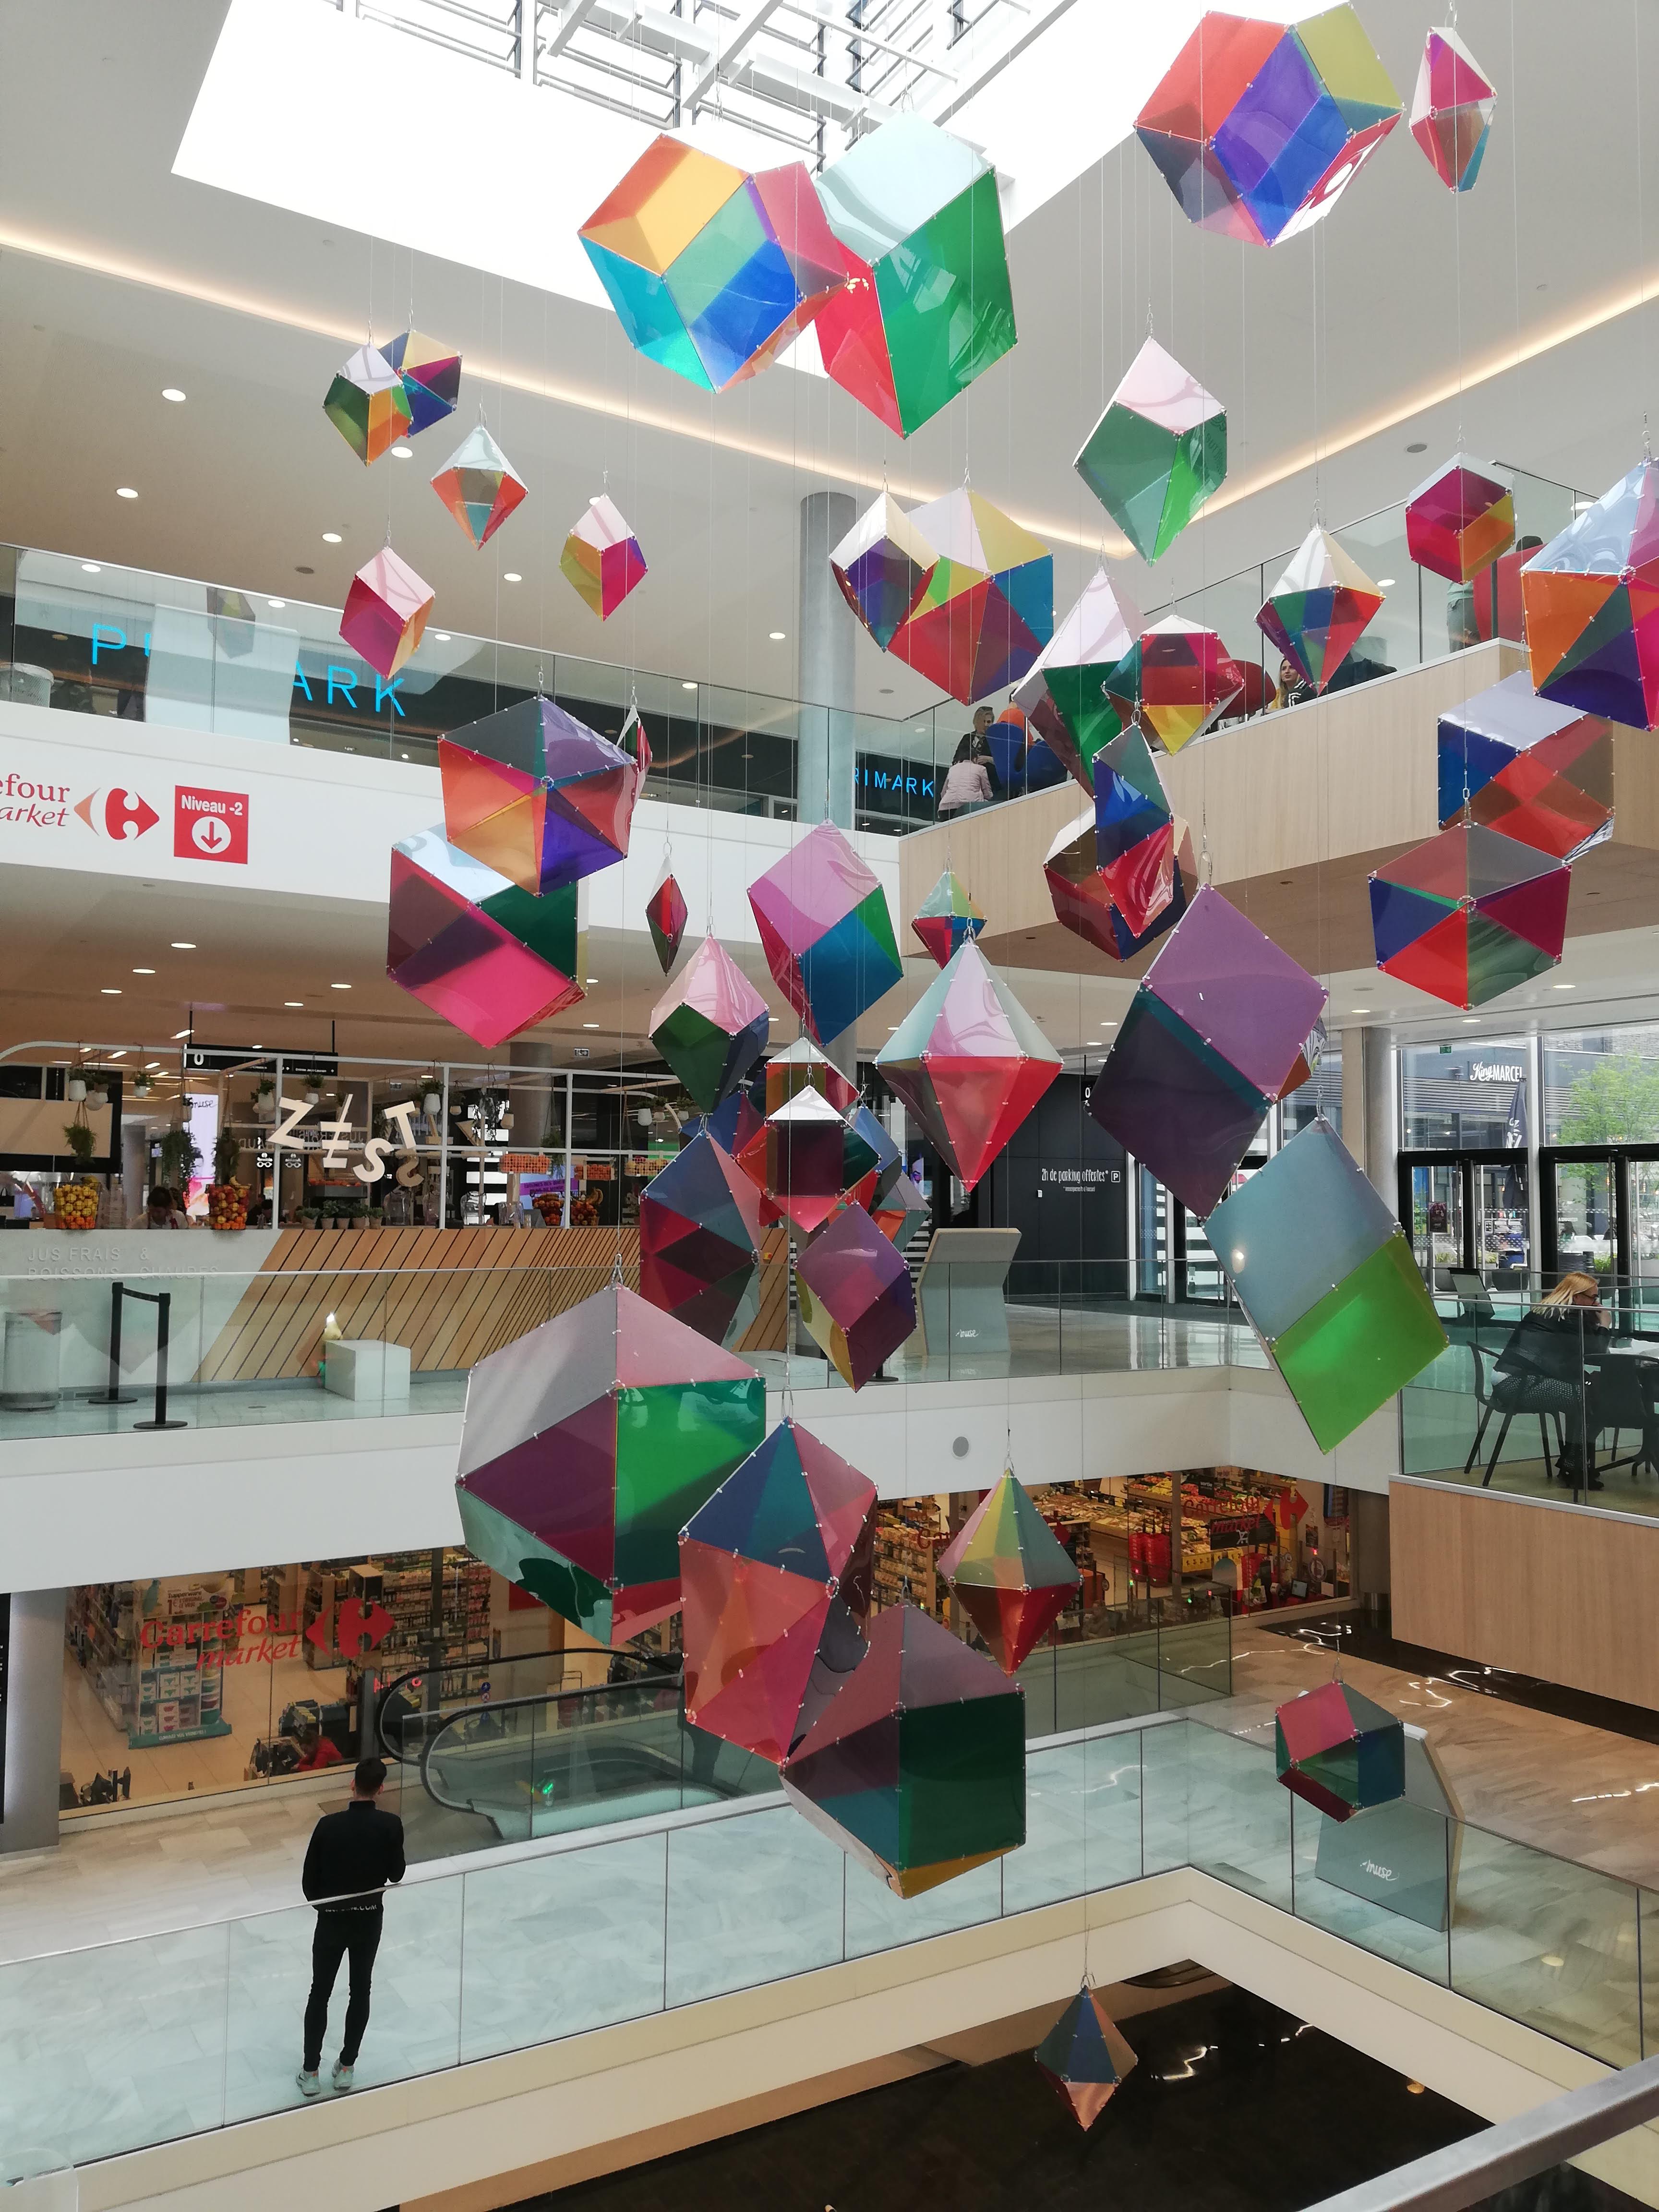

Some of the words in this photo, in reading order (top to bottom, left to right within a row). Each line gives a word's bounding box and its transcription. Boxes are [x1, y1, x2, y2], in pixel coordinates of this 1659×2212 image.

[854, 768, 934, 797] RIMARK
[0, 804, 70, 827] arket
[181, 794, 226, 814] Niveau
[229, 802, 243, 816] -2
[1042, 1168, 1048, 1181] 2h
[1050, 1168, 1057, 1181] de
[1058, 1169, 1080, 1183] parking
[28, 1248, 60, 1262] JUS
[69, 1248, 120, 1262] FRAIS
[955, 1329, 981, 1338] muse
[1183, 1496, 1260, 1517] Carrefour
[140, 1609, 303, 1649] Carrefour
[195, 1634, 302, 1671] market
[1359, 1859, 1399, 1881] muse
